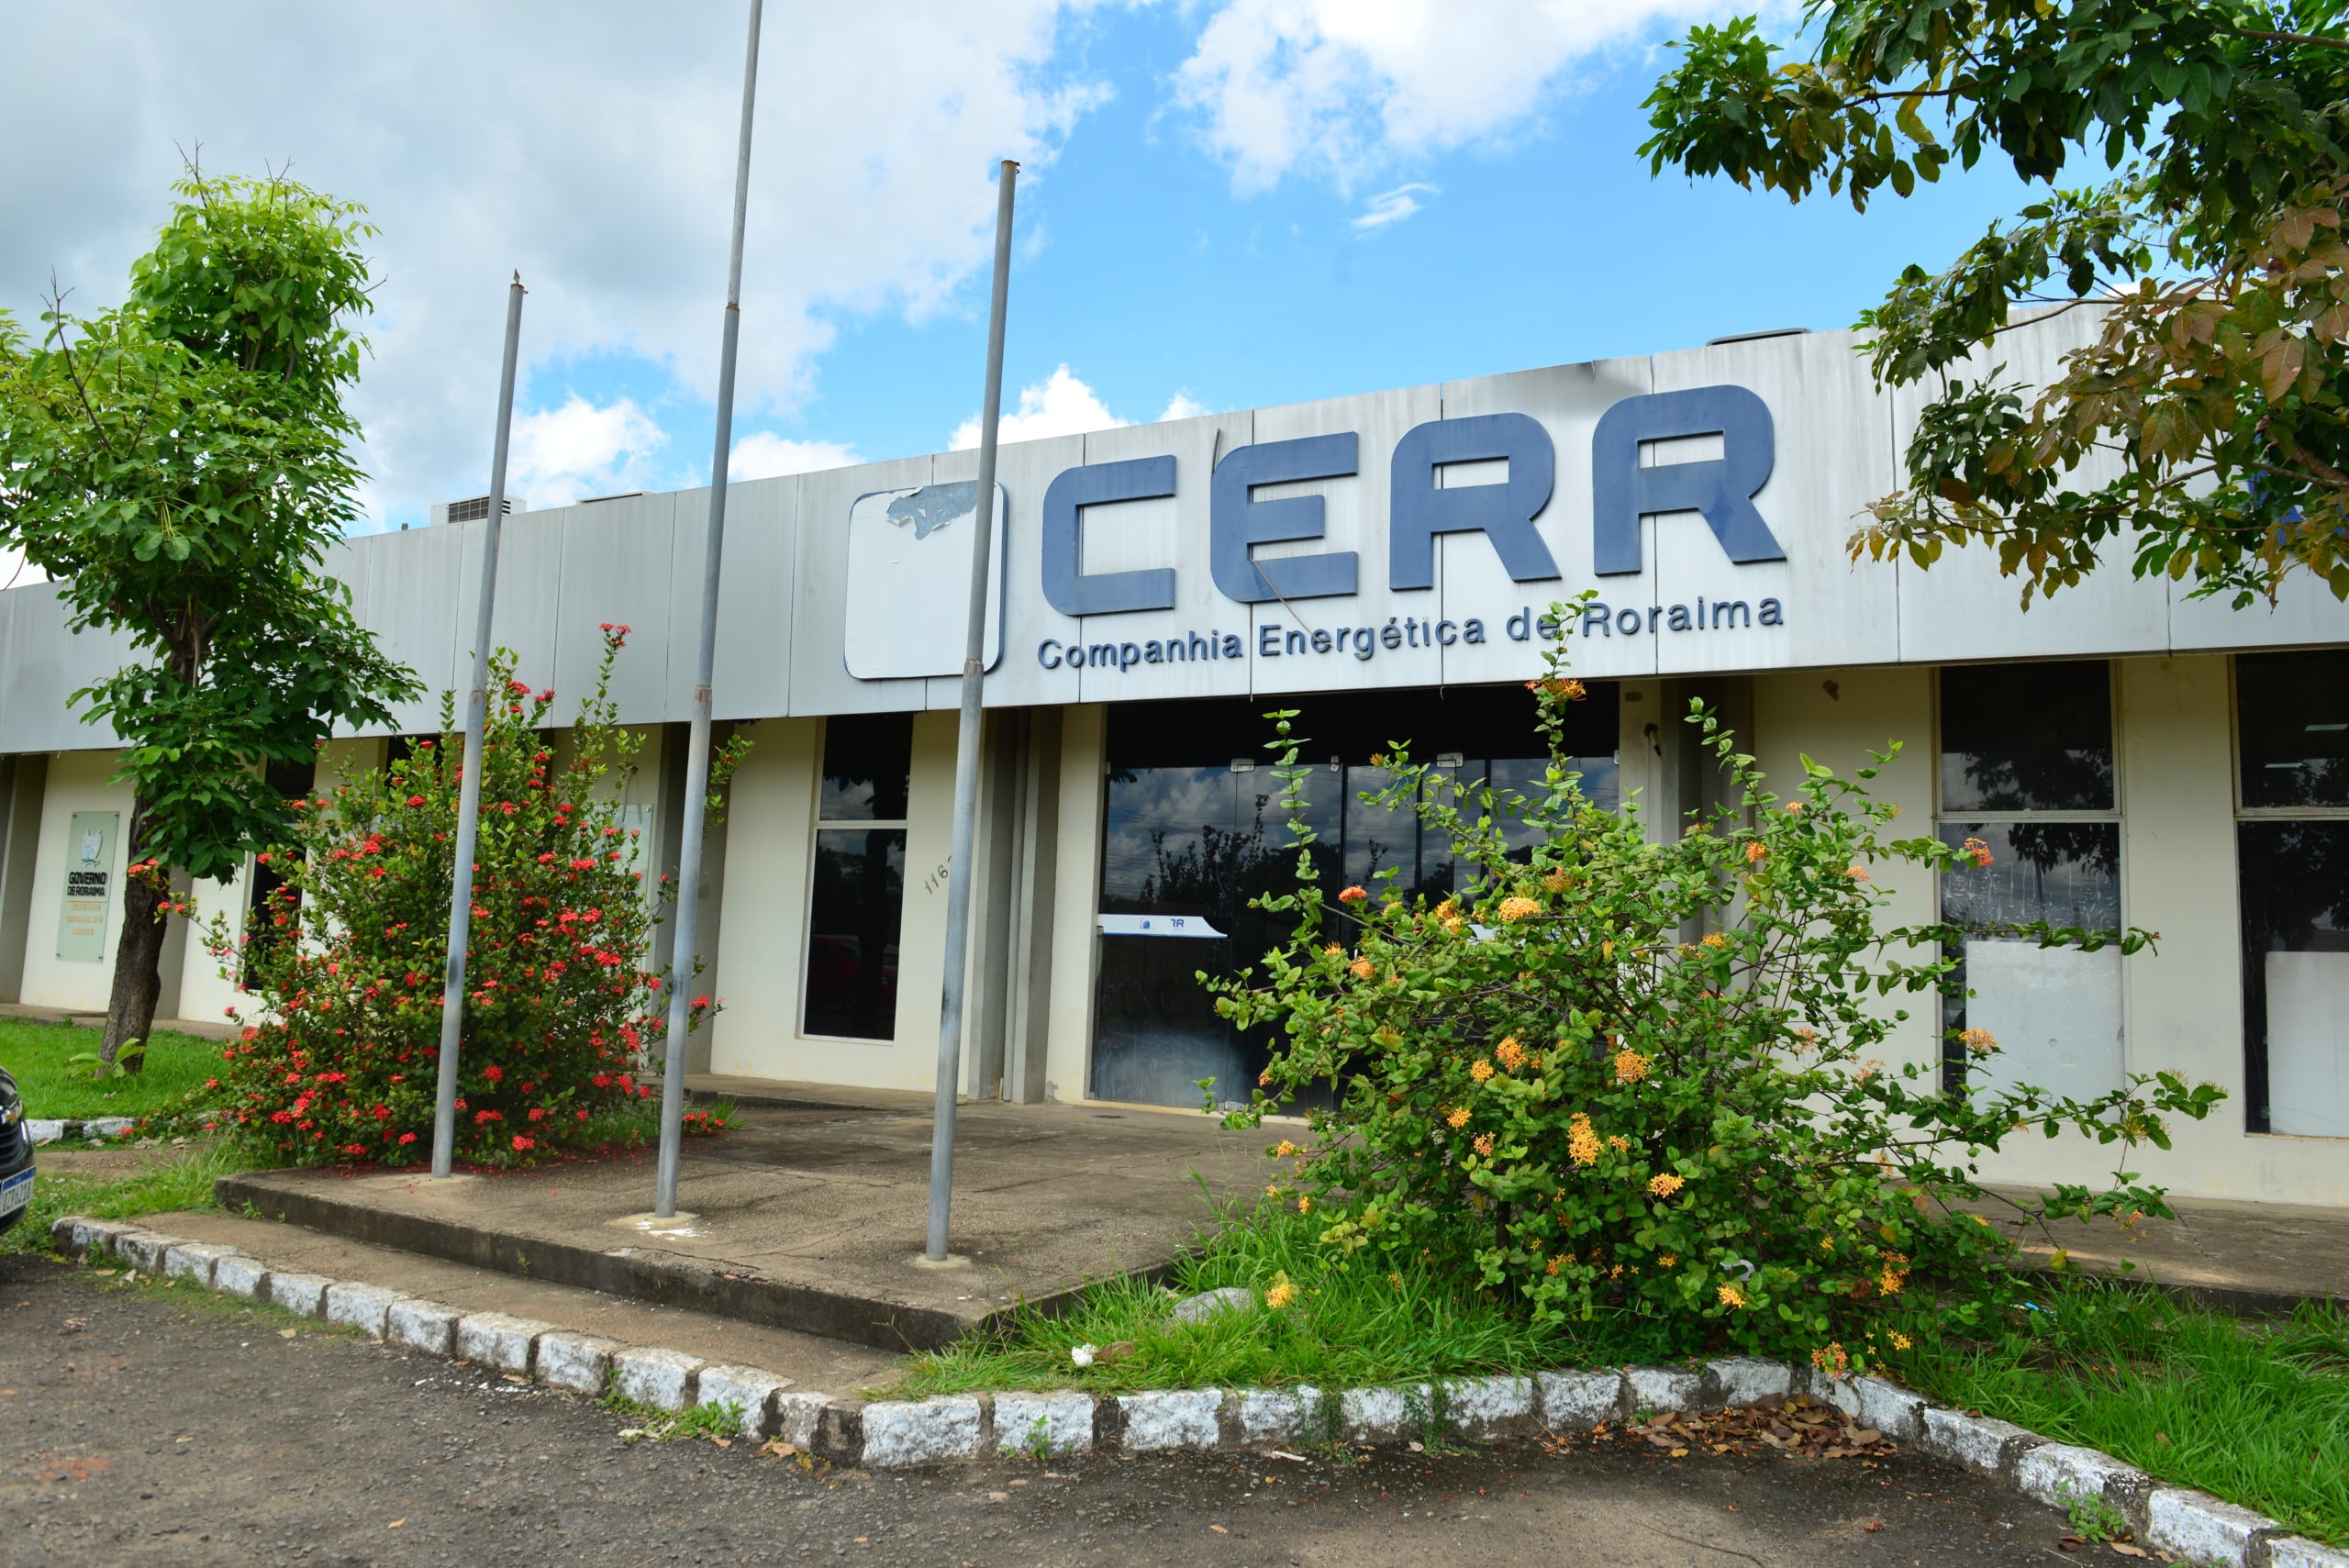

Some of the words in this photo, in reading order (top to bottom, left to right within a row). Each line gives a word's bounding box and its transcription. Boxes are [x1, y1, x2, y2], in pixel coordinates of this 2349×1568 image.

[1041, 384, 1787, 616] CERR
[1038, 629, 1242, 672] Companhia
[1259, 616, 1485, 661] Energética
[1506, 606, 1561, 639] de
[1583, 595, 1783, 637] Roraima
[69, 872, 107, 884] GOVERNO
[925, 854, 952, 895] 116
